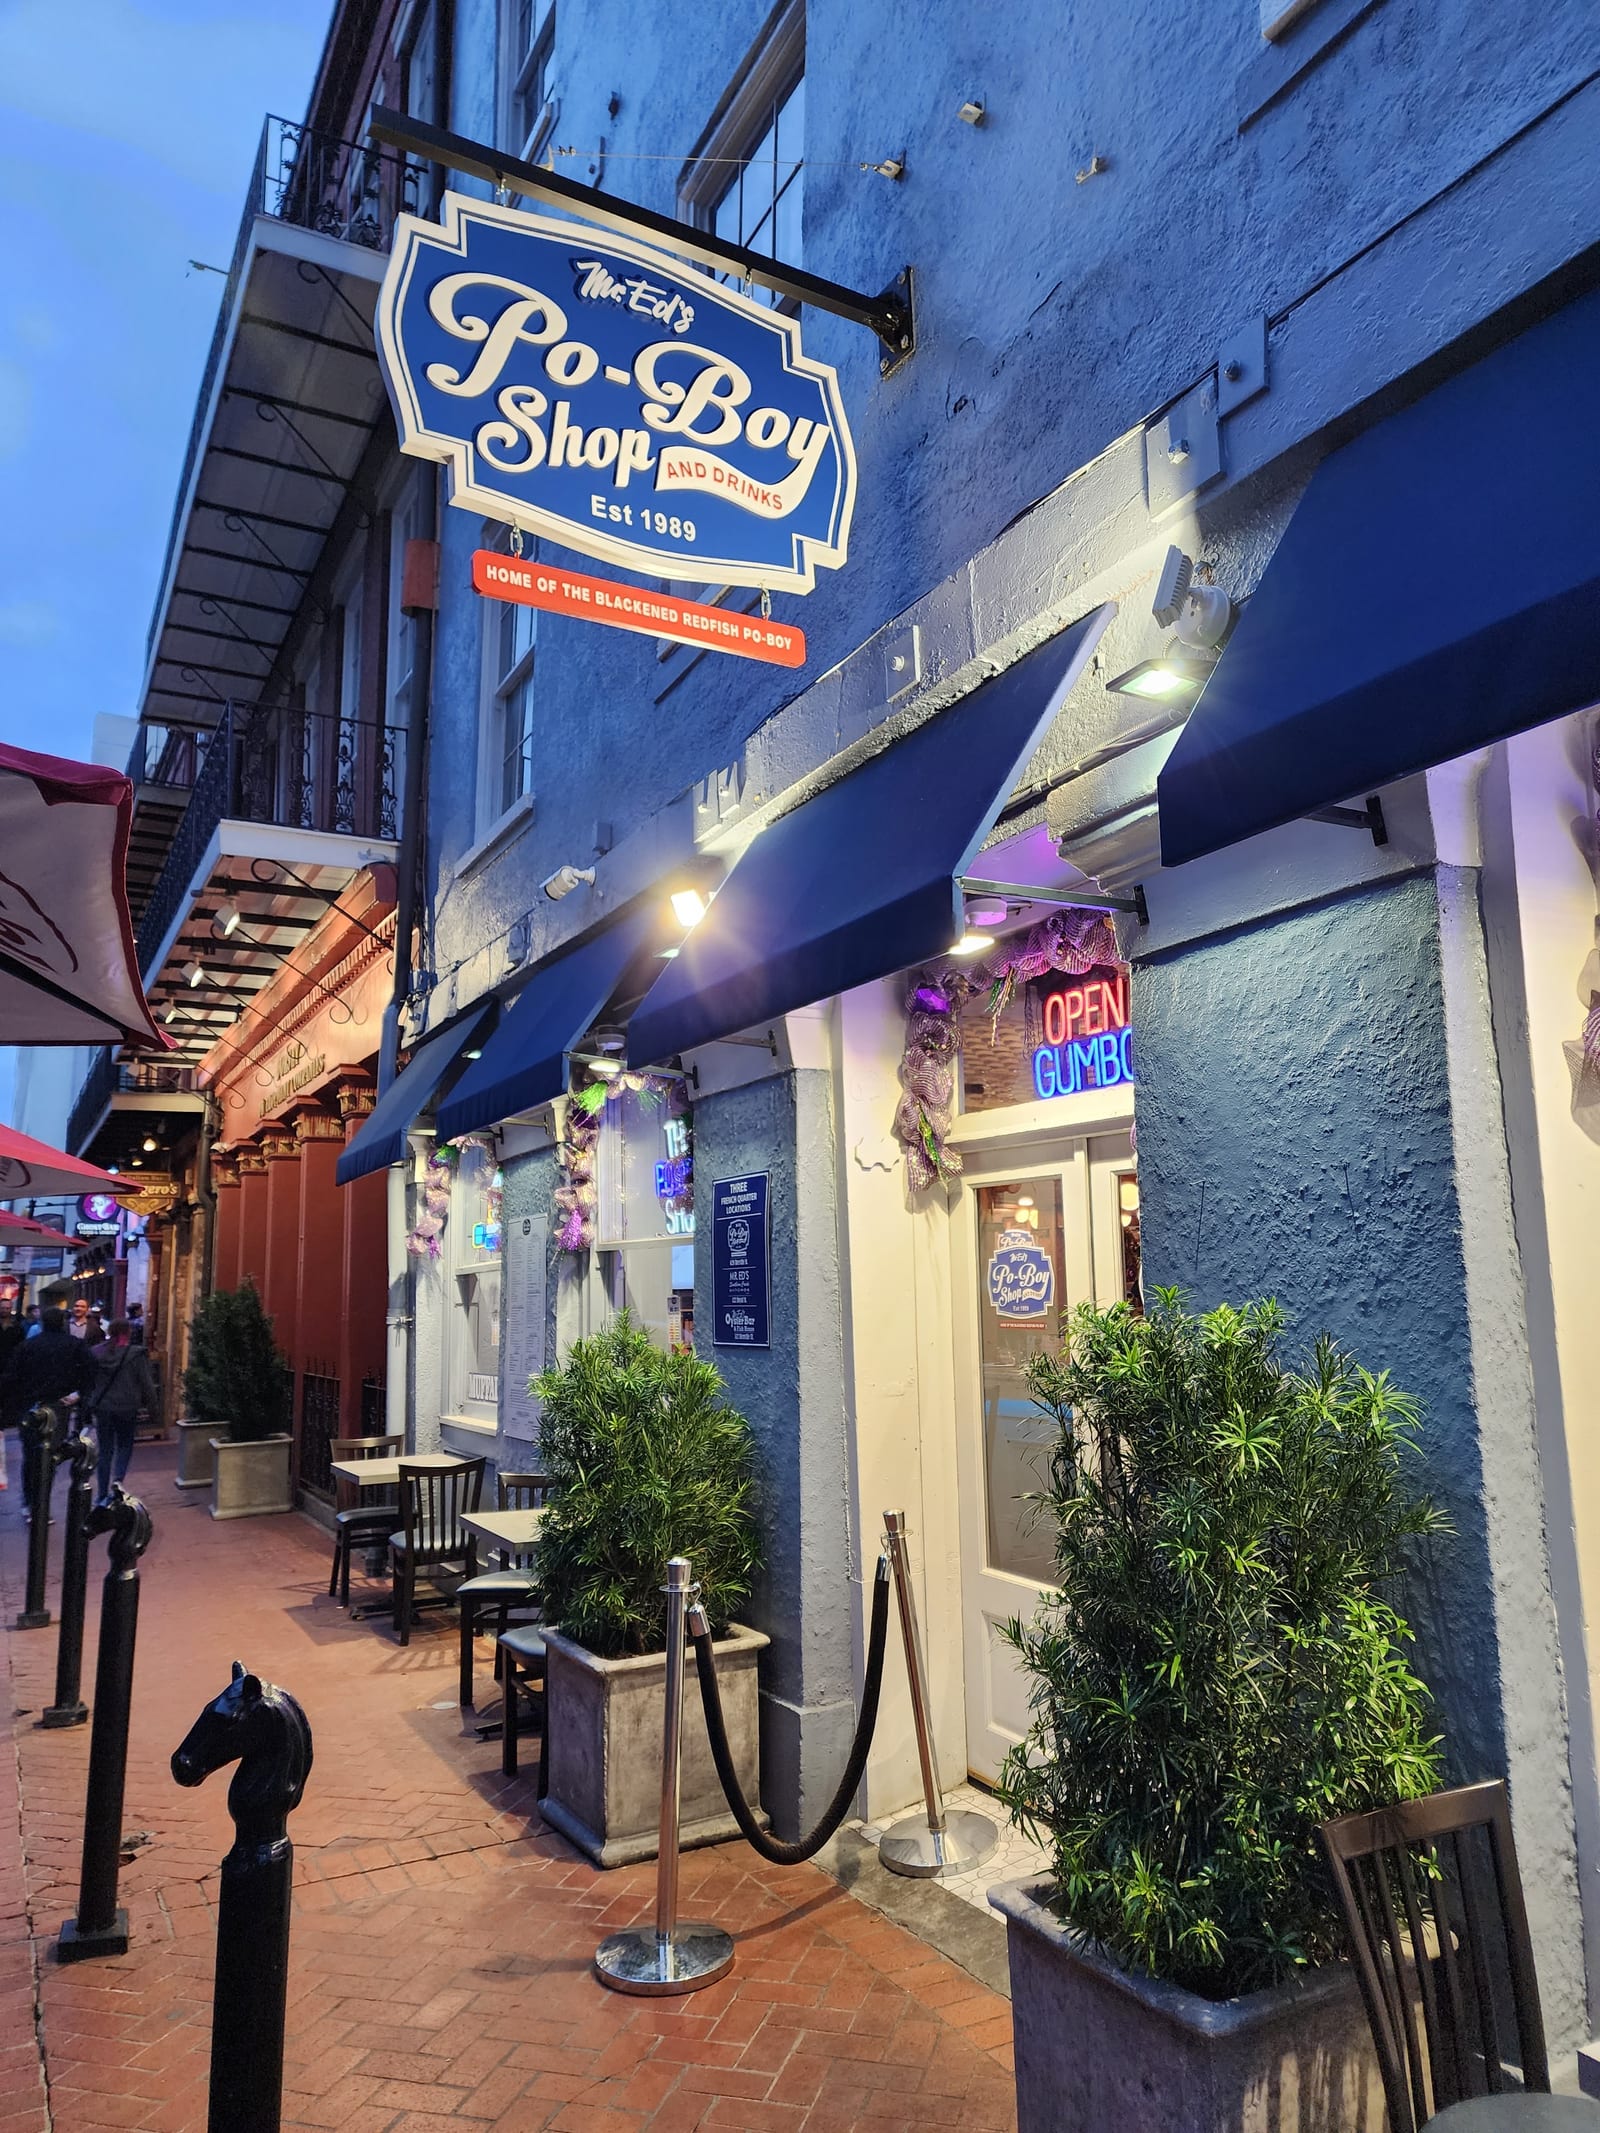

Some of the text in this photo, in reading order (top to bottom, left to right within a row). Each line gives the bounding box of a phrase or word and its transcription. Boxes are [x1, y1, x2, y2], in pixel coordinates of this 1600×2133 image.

[576, 261, 695, 335] Mr. Ed's
[426, 272, 831, 490] Po-Boy
[477, 386, 655, 488] Shop
[666, 461, 783, 510] AND DRINKS
[590, 494, 697, 543] Est 1989
[486, 564, 793, 651] HOME OF THE BLACKENED REDFISH PO-BOY
[1044, 977, 1125, 1045] OPEN
[1034, 1028, 1133, 1098] GUMBO
[139, 1183, 177, 1197] gero's
[720, 1192, 757, 1205] FRENCH QUARTER
[725, 1203, 751, 1214] LOCATIONS
[730, 1181, 748, 1194] THREE
[992, 1263, 1050, 1294] Po-Boy
[999, 1286, 1022, 1306] Shop
[725, 1313, 744, 1328] Oyster
[744, 1316, 755, 1326] Bar
